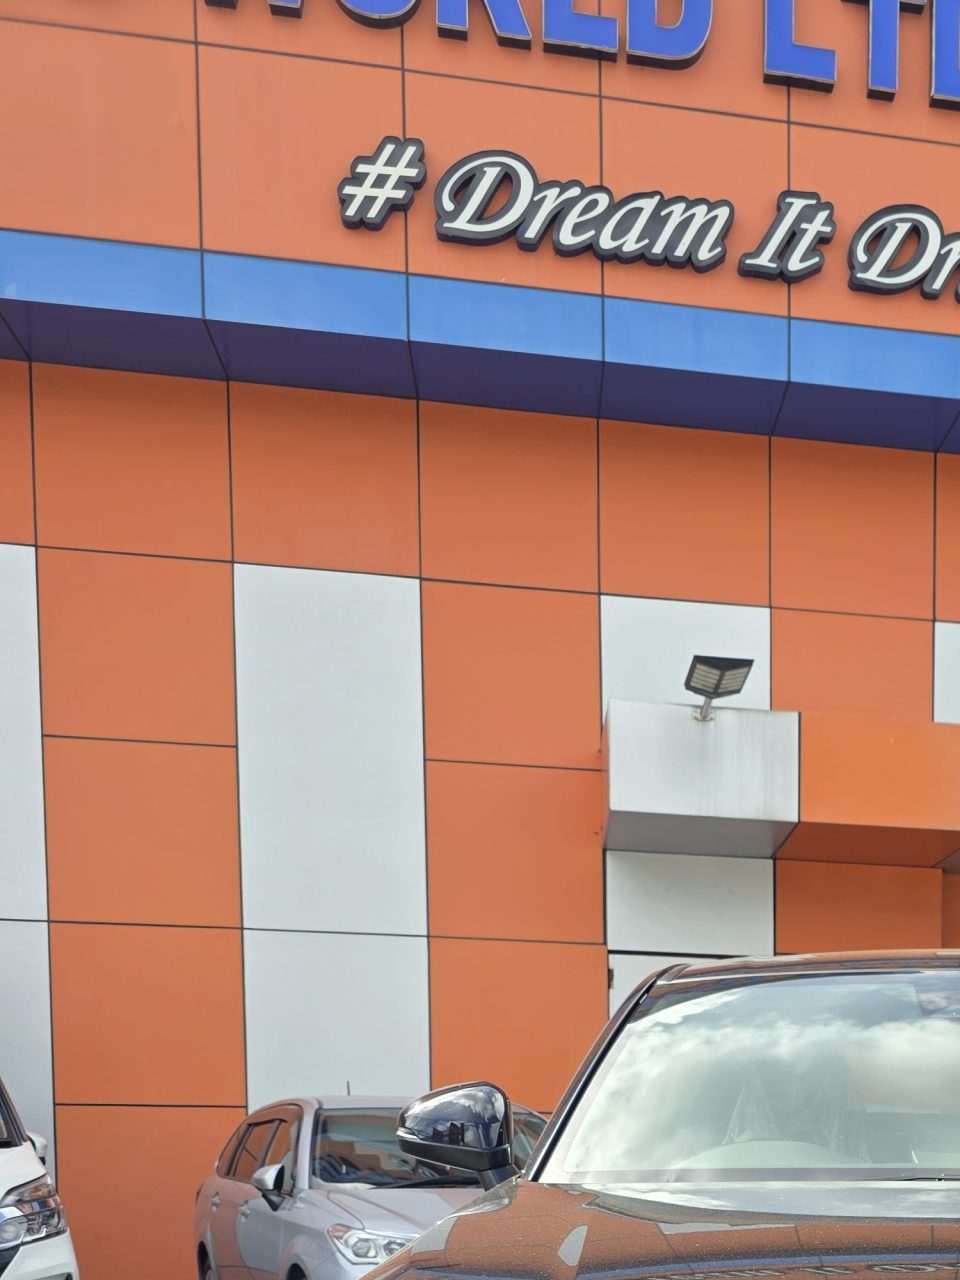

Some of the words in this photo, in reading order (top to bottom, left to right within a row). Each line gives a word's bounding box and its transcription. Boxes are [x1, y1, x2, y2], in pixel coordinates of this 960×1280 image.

[339, 137, 427, 230] #
[436, 150, 734, 272] Dream
[739, 190, 836, 282] It
